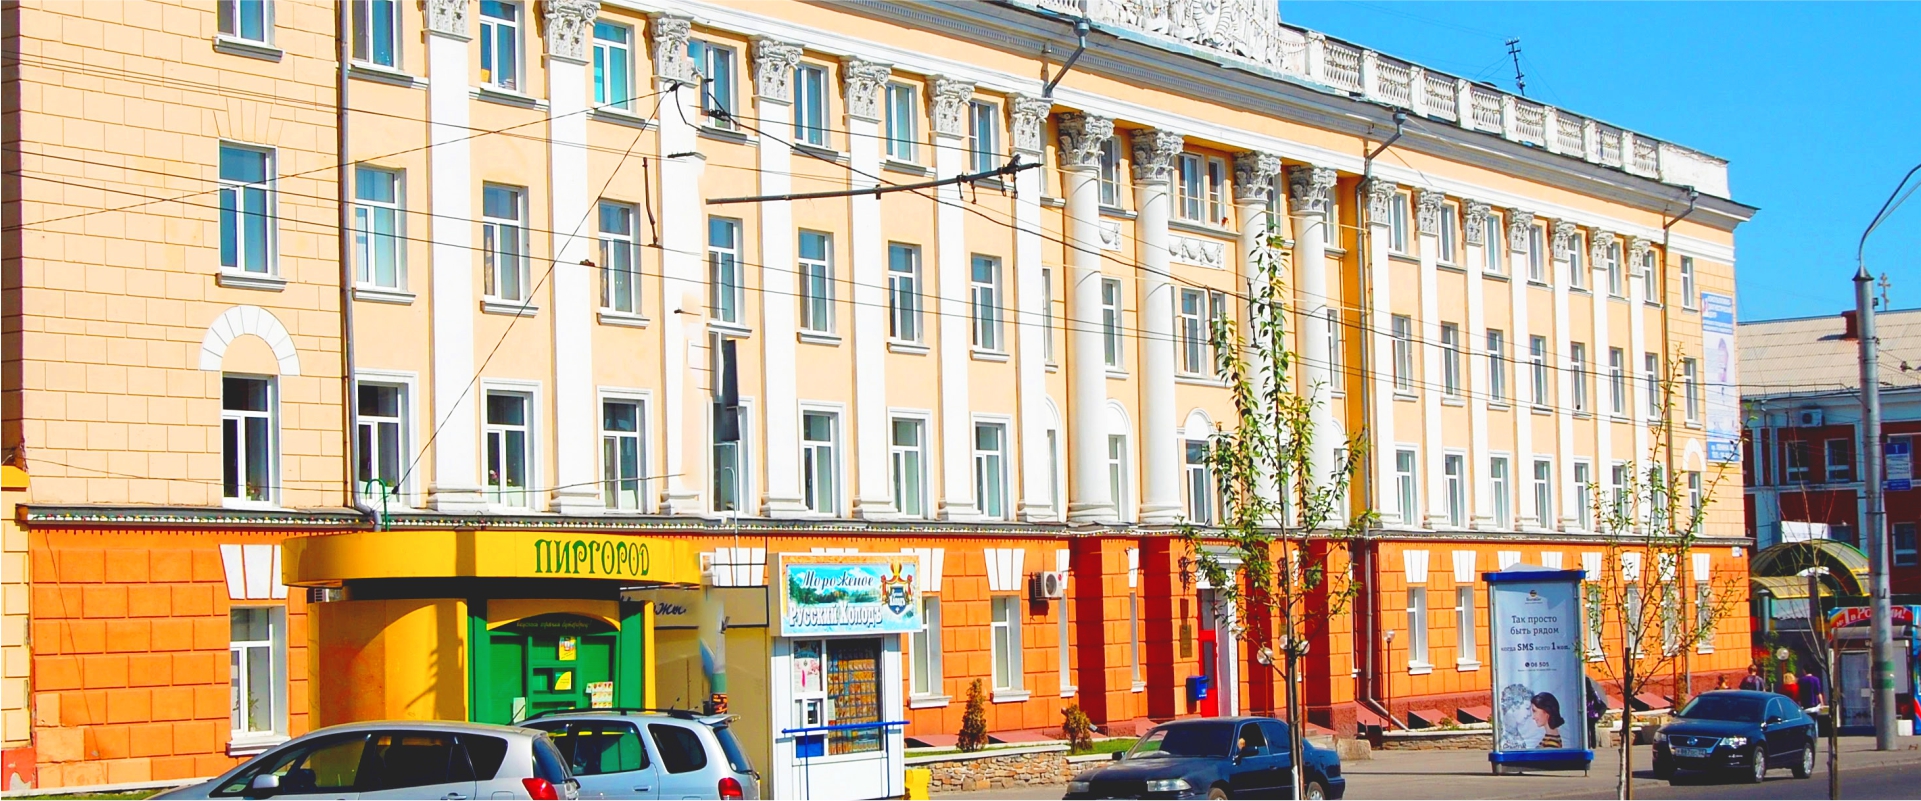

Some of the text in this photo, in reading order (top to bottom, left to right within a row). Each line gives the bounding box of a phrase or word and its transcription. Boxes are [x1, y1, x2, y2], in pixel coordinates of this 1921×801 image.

[534, 539, 650, 576] ПИРГОРОД
[803, 570, 874, 591] Мороженое
[788, 600, 883, 628] Русский Холодъ
[1511, 615, 1558, 625] Так просто
[1510, 627, 1560, 636] быть рядом
[1517, 643, 1534, 651] SMS
[1551, 642, 1556, 650] 1
